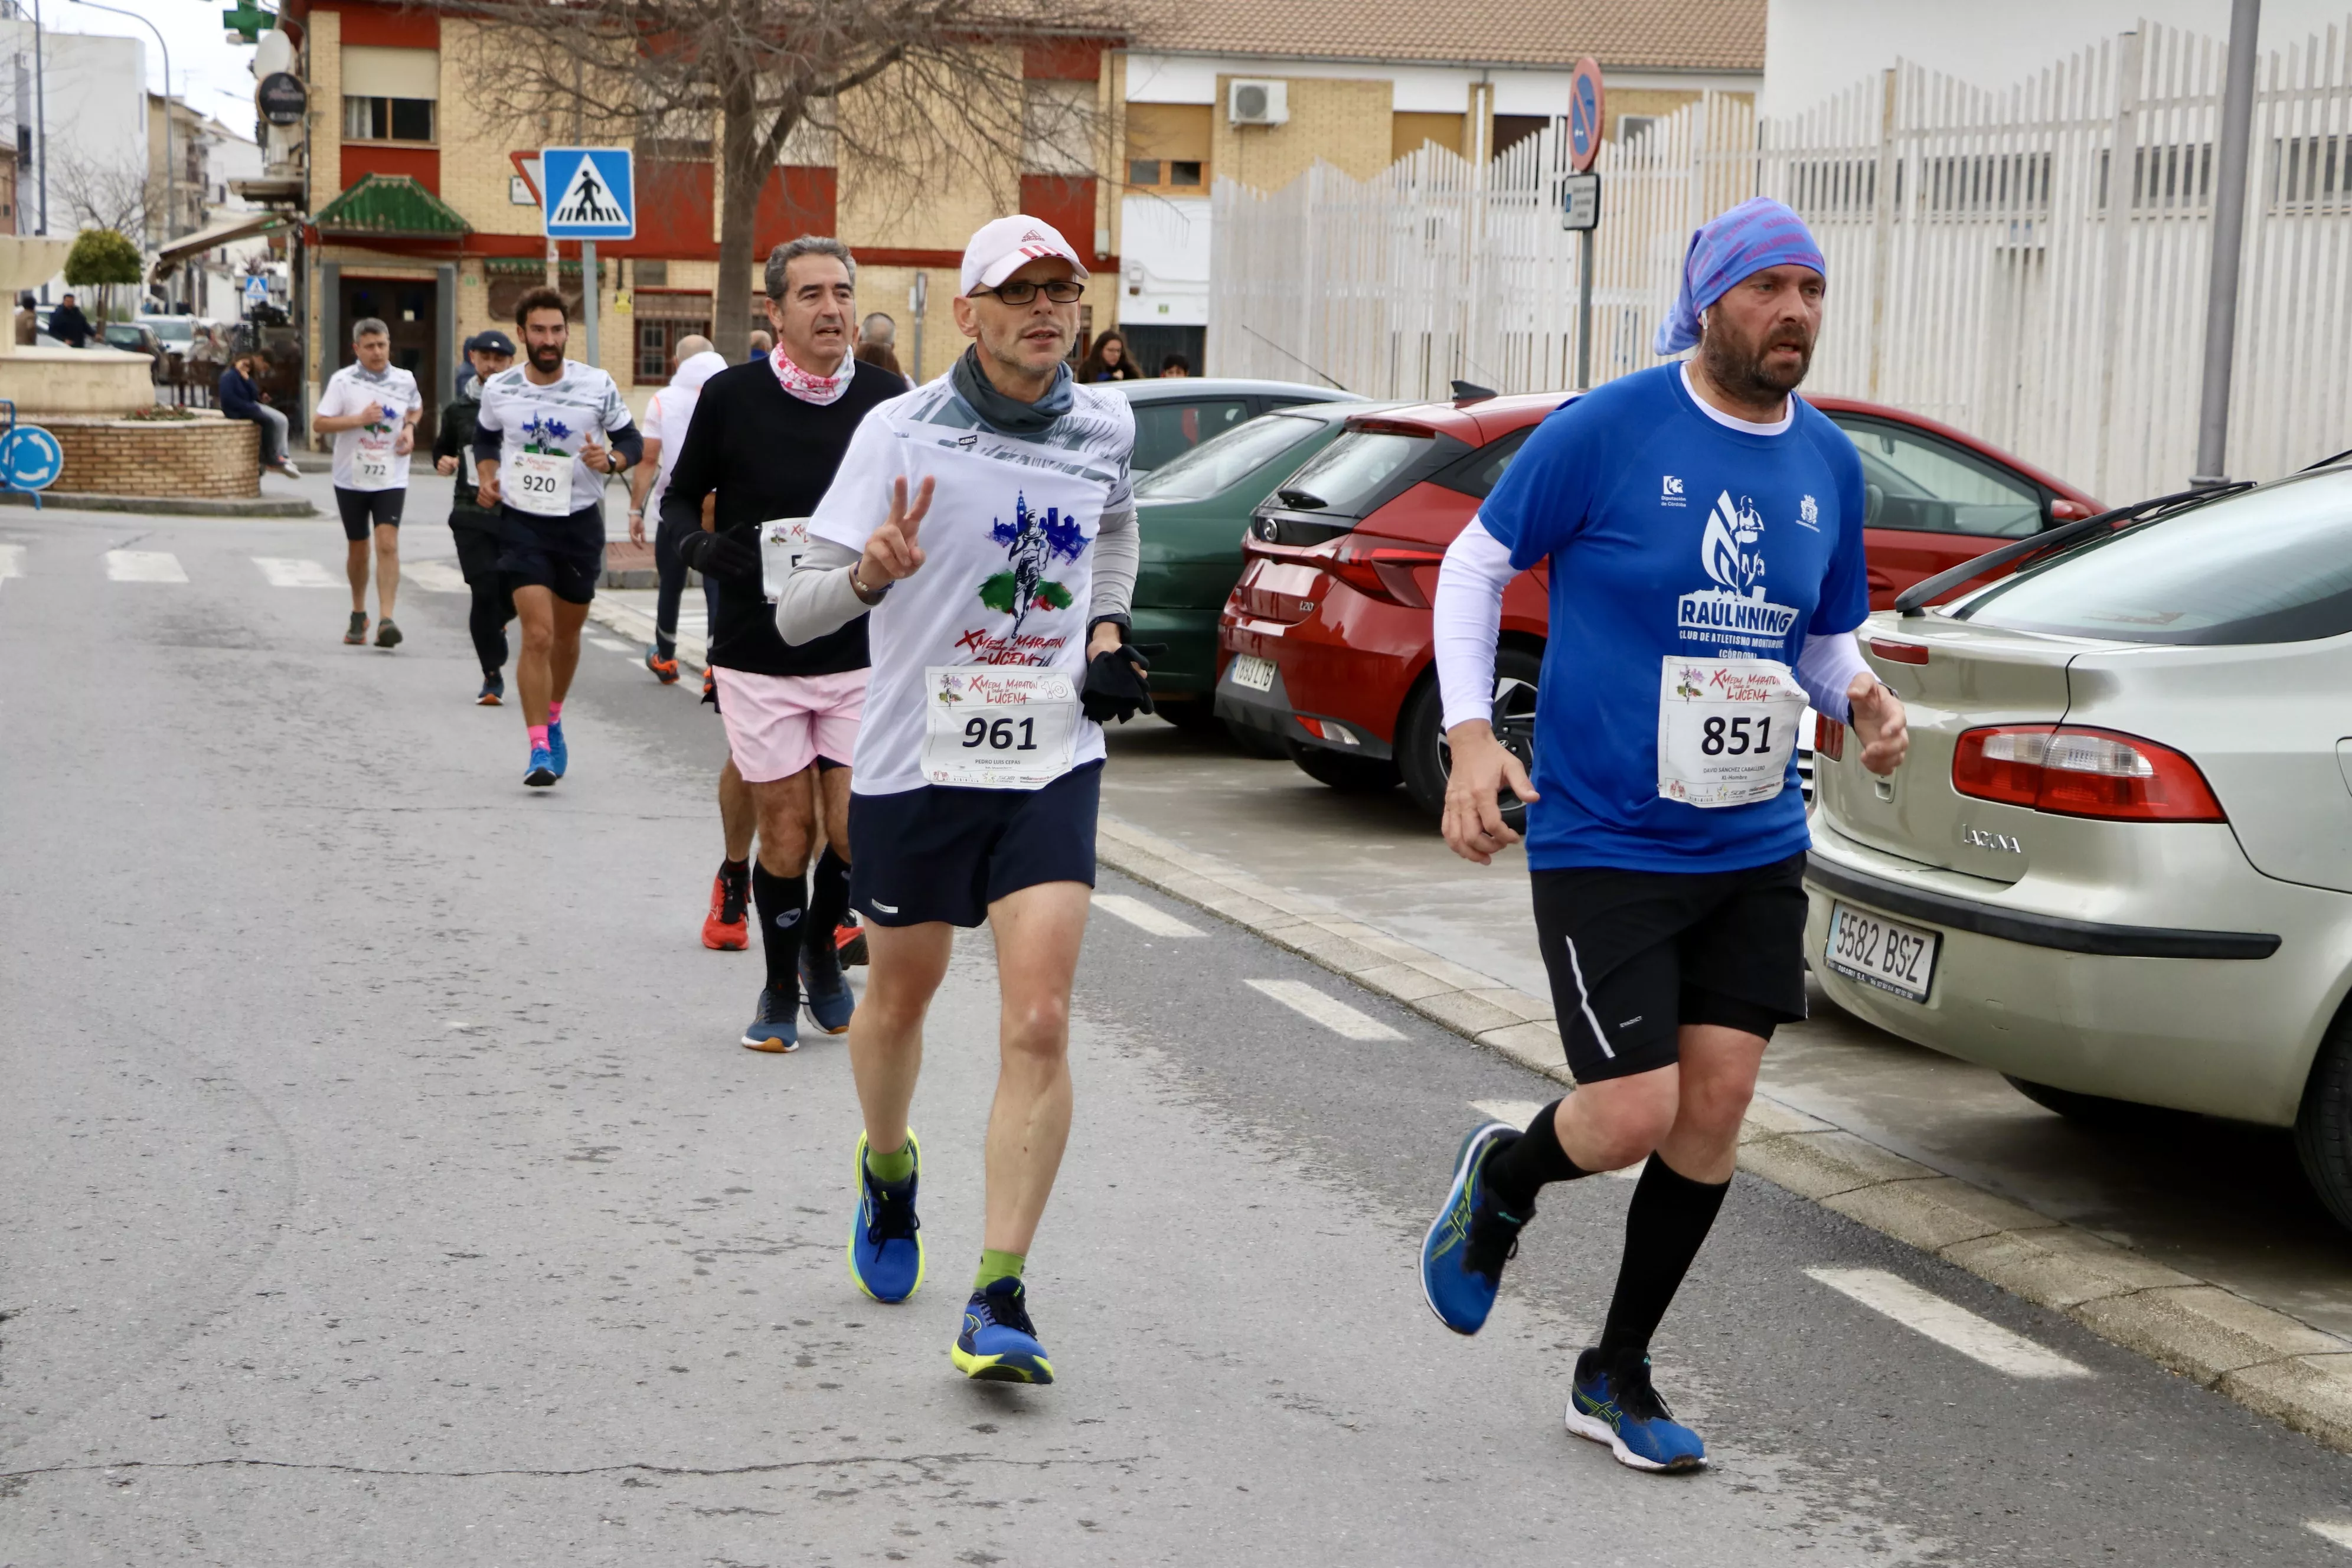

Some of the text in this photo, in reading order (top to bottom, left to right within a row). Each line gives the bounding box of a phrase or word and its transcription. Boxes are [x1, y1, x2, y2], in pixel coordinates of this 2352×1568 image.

[524, 475, 556, 492] 920
[1681, 598, 1793, 632] RAÚLNNING
[1680, 630, 1785, 648] CLUB DE ATLETISMO MONTURQUE
[1254, 661, 1273, 686] LTB
[986, 691, 1033, 705] LUCENA
[1727, 686, 1772, 702] LUCENA
[962, 717, 1037, 750] 961
[1701, 716, 1771, 755] 851
[1962, 824, 2021, 853] LAGUNA
[1837, 911, 1925, 983] 5582 BSZ
